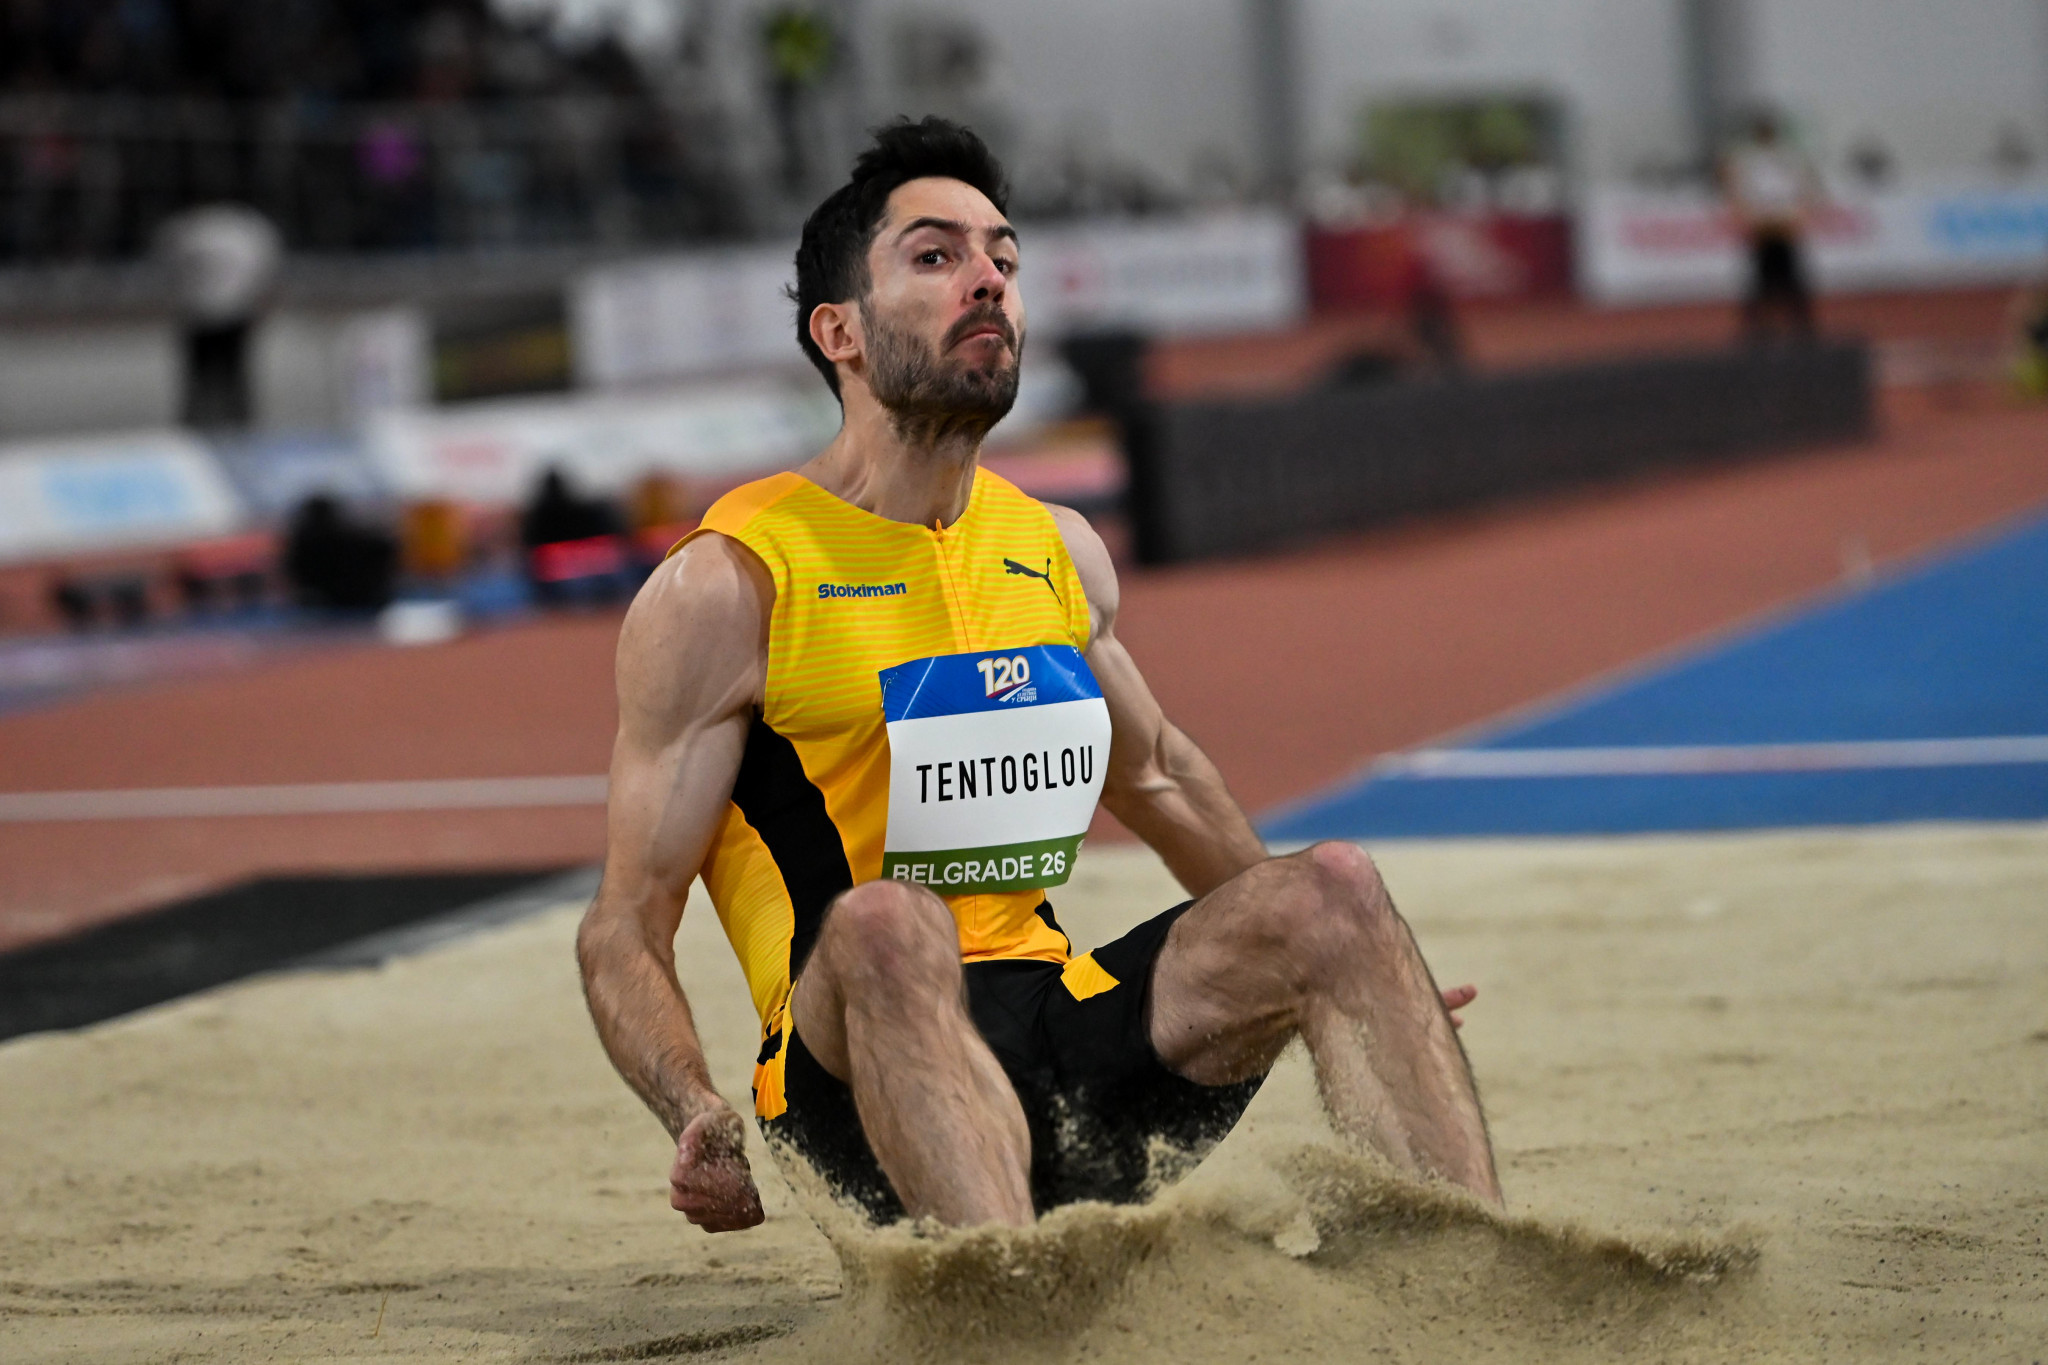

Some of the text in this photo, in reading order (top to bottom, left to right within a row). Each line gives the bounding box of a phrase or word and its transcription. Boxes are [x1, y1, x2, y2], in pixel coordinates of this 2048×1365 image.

[817, 582, 907, 599] Stoiximan
[976, 654, 1030, 697] 120
[916, 745, 1093, 803] TENTOGLOU
[893, 850, 1066, 885] BELGRADE 26
